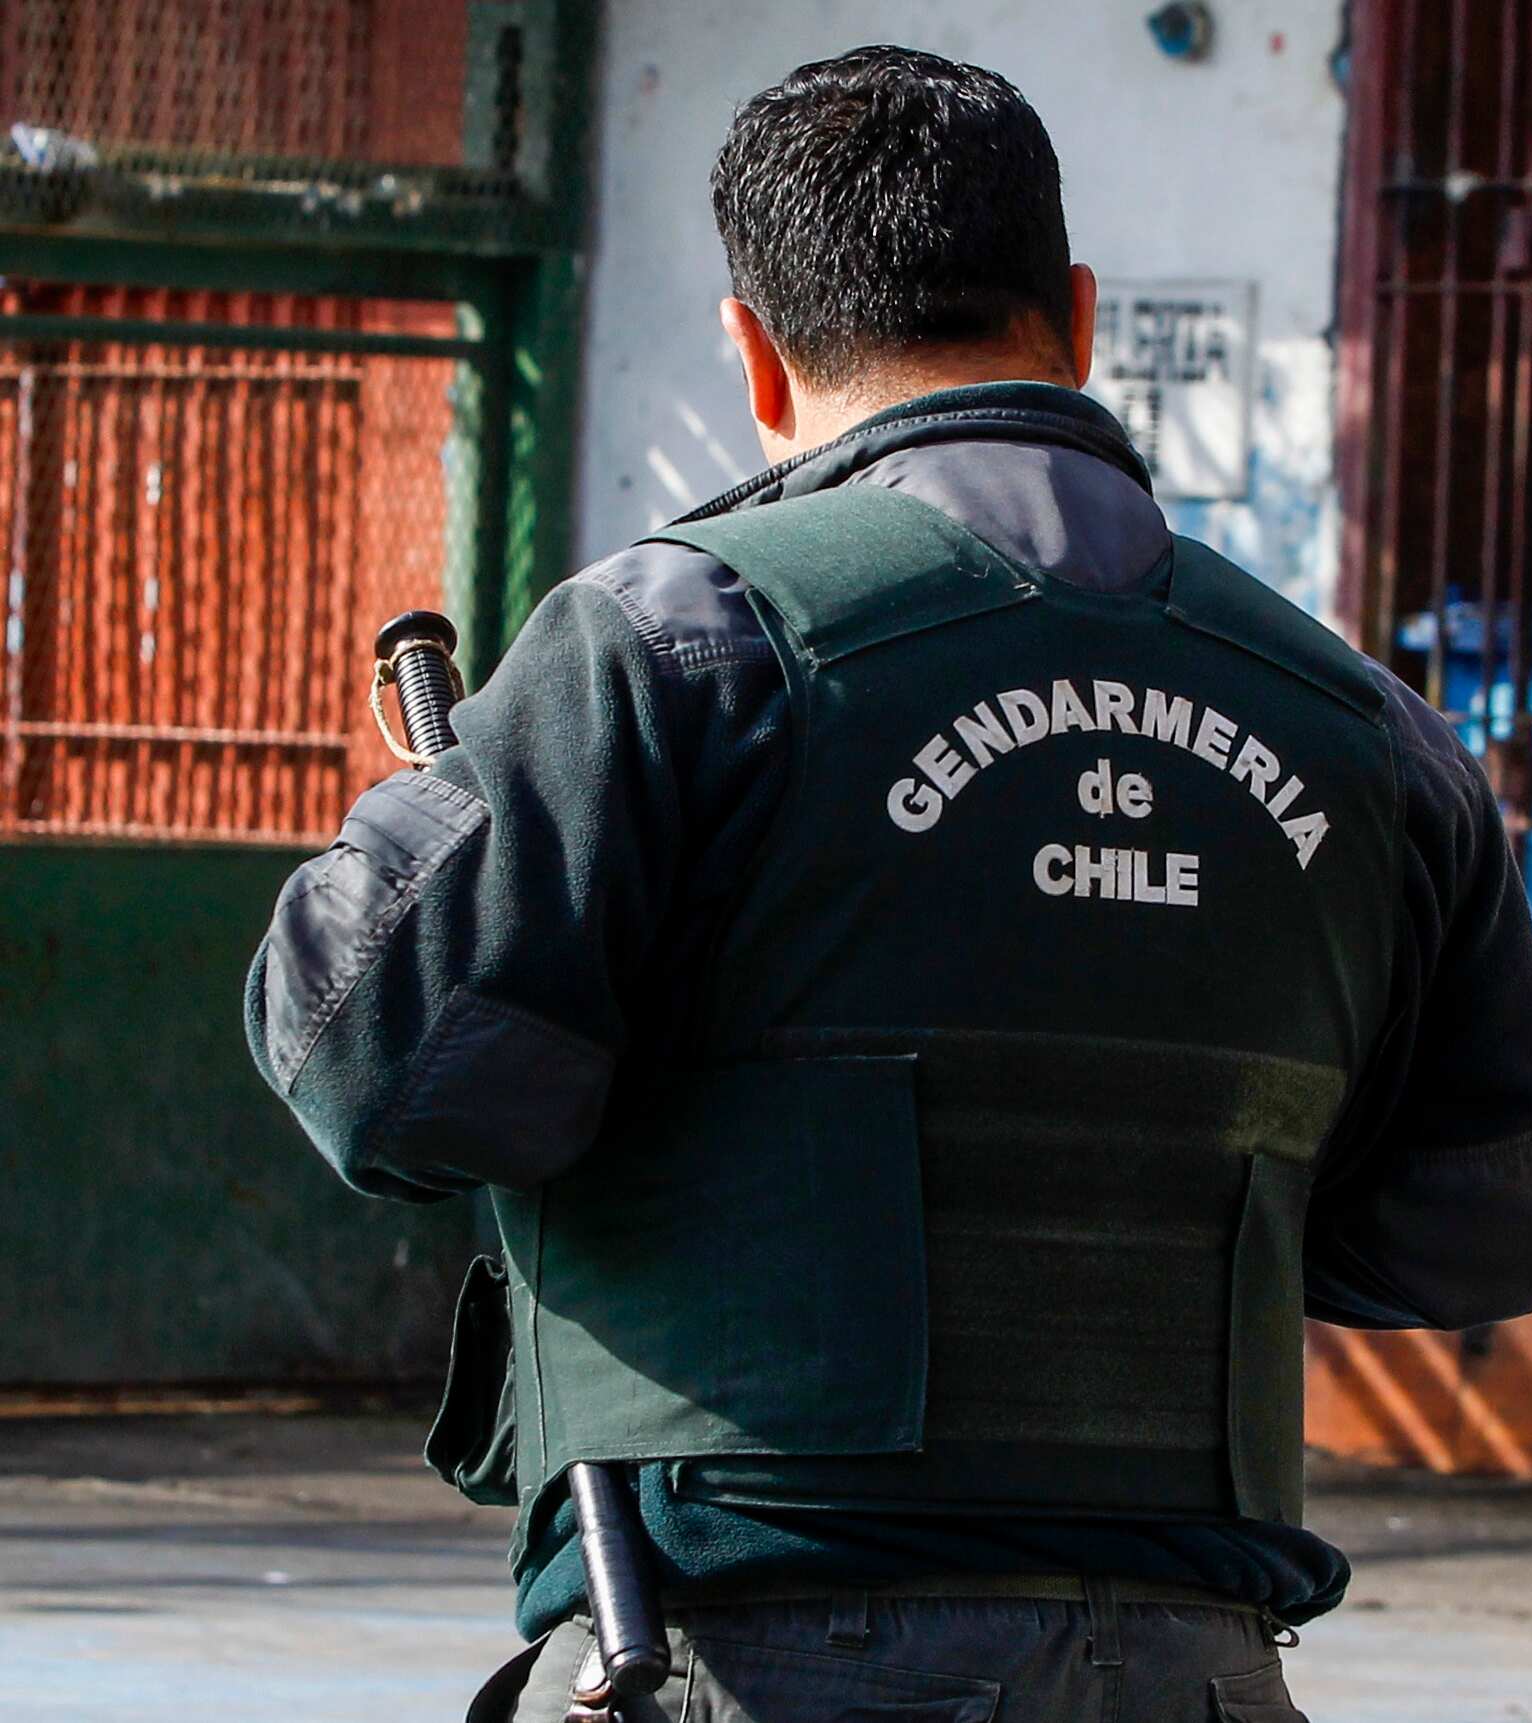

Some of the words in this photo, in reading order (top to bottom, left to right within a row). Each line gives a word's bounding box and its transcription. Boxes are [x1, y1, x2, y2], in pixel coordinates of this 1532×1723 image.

[886, 679, 1330, 871] GENDARMERIA
[1077, 758, 1154, 818] de
[1033, 843, 1200, 907] CHILE
